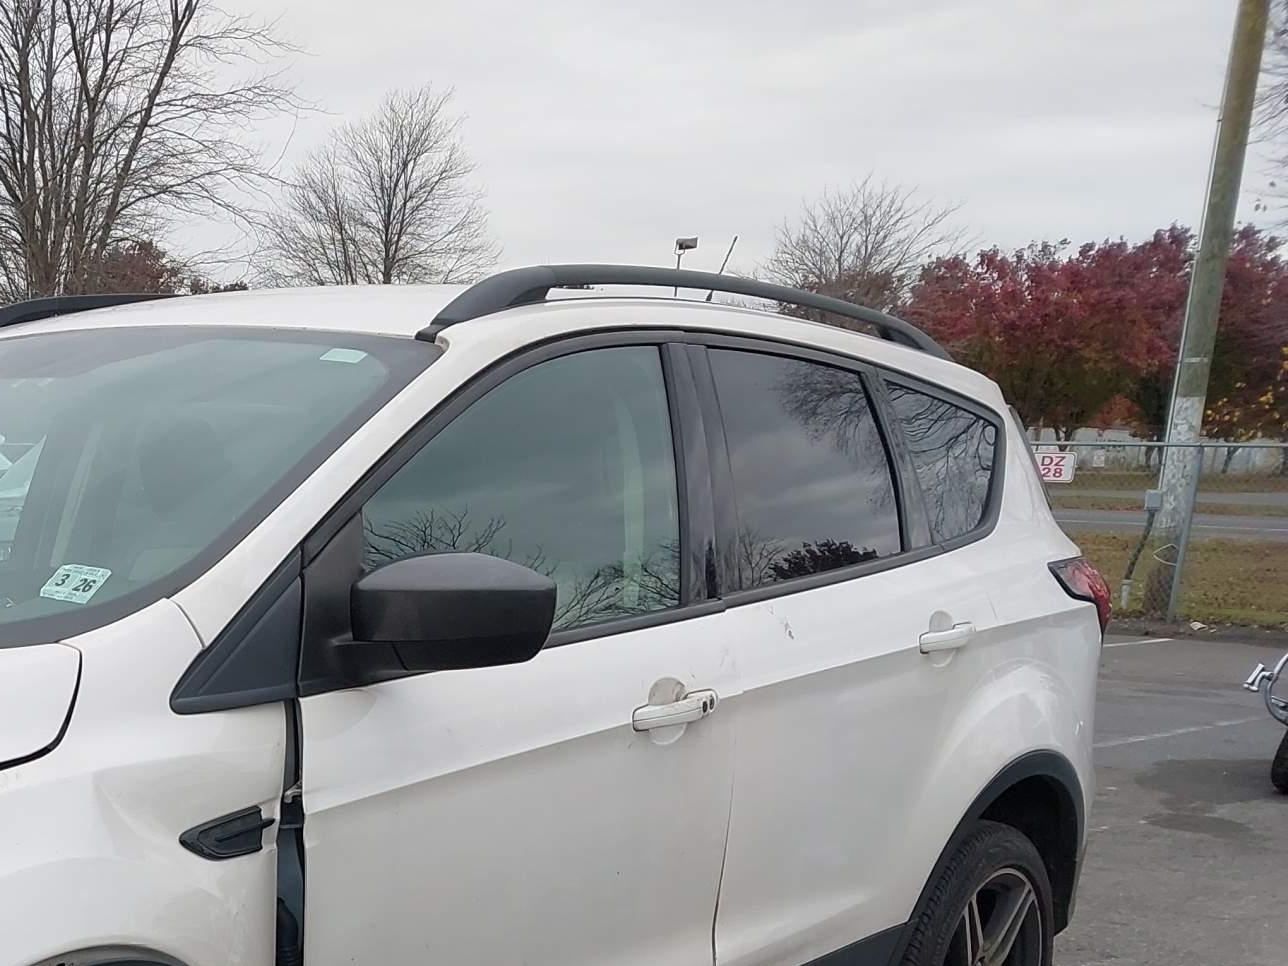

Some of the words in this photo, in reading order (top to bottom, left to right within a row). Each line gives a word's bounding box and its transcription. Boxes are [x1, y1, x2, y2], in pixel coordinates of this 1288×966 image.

[1041, 455, 1066, 467] DZ
[1041, 467, 1063, 478] 28
[55, 573, 71, 587] 3
[72, 577, 97, 593] 26
